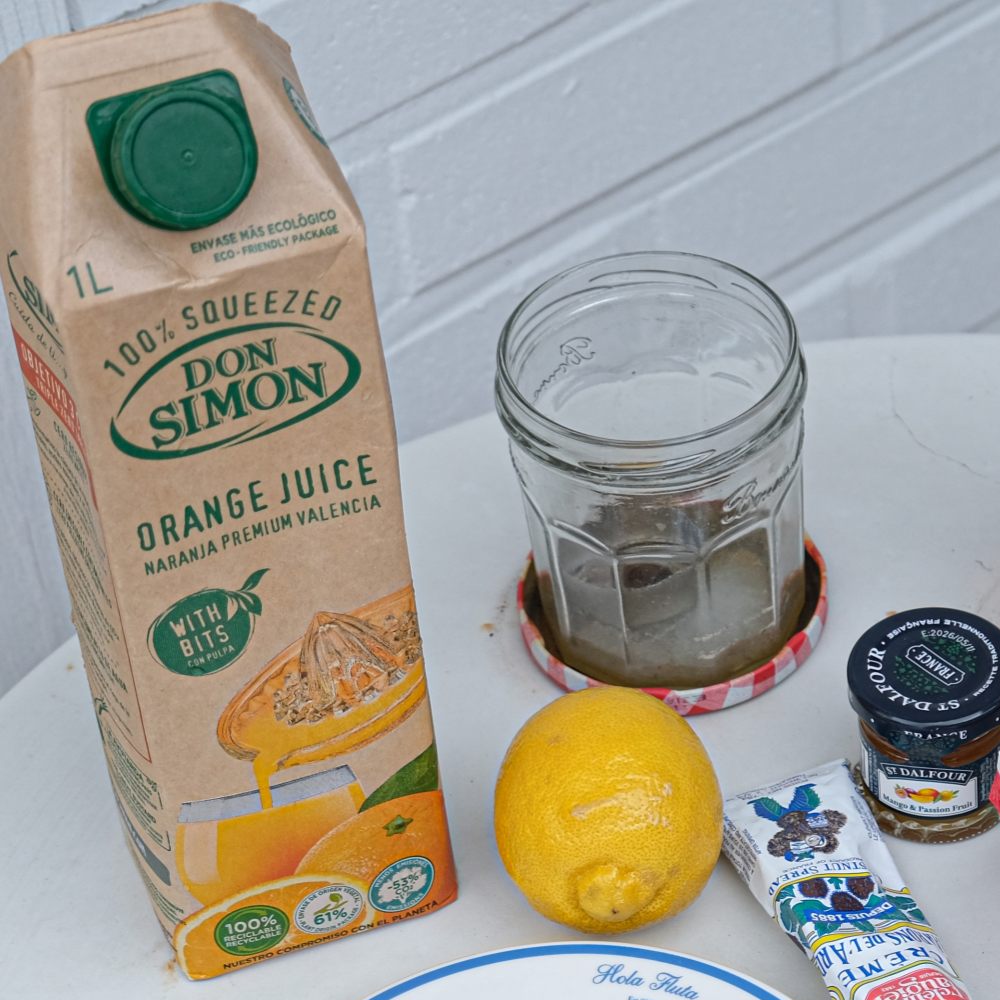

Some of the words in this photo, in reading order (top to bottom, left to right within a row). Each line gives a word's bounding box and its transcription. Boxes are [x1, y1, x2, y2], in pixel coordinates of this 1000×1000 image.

[190, 232, 238, 254] ENVASE
[239, 223, 265, 242] MÁS
[268, 209, 337, 236] ECOLÓGICO
[292, 224, 340, 245] PACKAGE
[103, 319, 176, 378] 100%
[181, 289, 342, 330] SQUEEZED
[180, 338, 278, 392] DON
[148, 362, 328, 450] SIMON
[137, 480, 268, 551] ORANGE
[280, 455, 377, 504] JUICE
[144, 542, 218, 576] NARANJA
[221, 514, 293, 550] PREMIUM
[297, 494, 381, 525] VALENCIA
[169, 601, 222, 639] WITH
[887, 618, 941, 639] FRANÇAISE
[179, 627, 230, 658] BITS
[943, 618, 999, 664] TRADITIONNELLE
[187, 654, 204, 669] CON
[207, 643, 235, 665] PULPA
[915, 650, 955, 680] FRANCE
[867, 647, 933, 711] DALFOUR
[973, 665, 999, 697] RECETTE
[899, 767, 968, 781] DALFOUR
[882, 794, 908, 811] Mango
[918, 805, 951, 813] Passion
[952, 801, 974, 811] Fruit
[821, 859, 867, 874] STNUT
[387, 873, 419, 892] -53%
[768, 864, 820, 897] SPREAD
[224, 913, 278, 935] 100%
[313, 908, 348, 926] 61%
[811, 912, 845, 924] 1885
[845, 901, 896, 923] DEPUIS
[223, 924, 282, 943] RECICLABLE
[223, 951, 274, 970] NUESTRO
[276, 930, 349, 956] COMPROMISO
[351, 922, 375, 934] CON
[377, 918, 390, 927] EL
[392, 900, 439, 922] PLANETA
[226, 931, 282, 948] RECYCLABLE
[861, 930, 884, 949] DE
[592, 963, 645, 987] Hola
